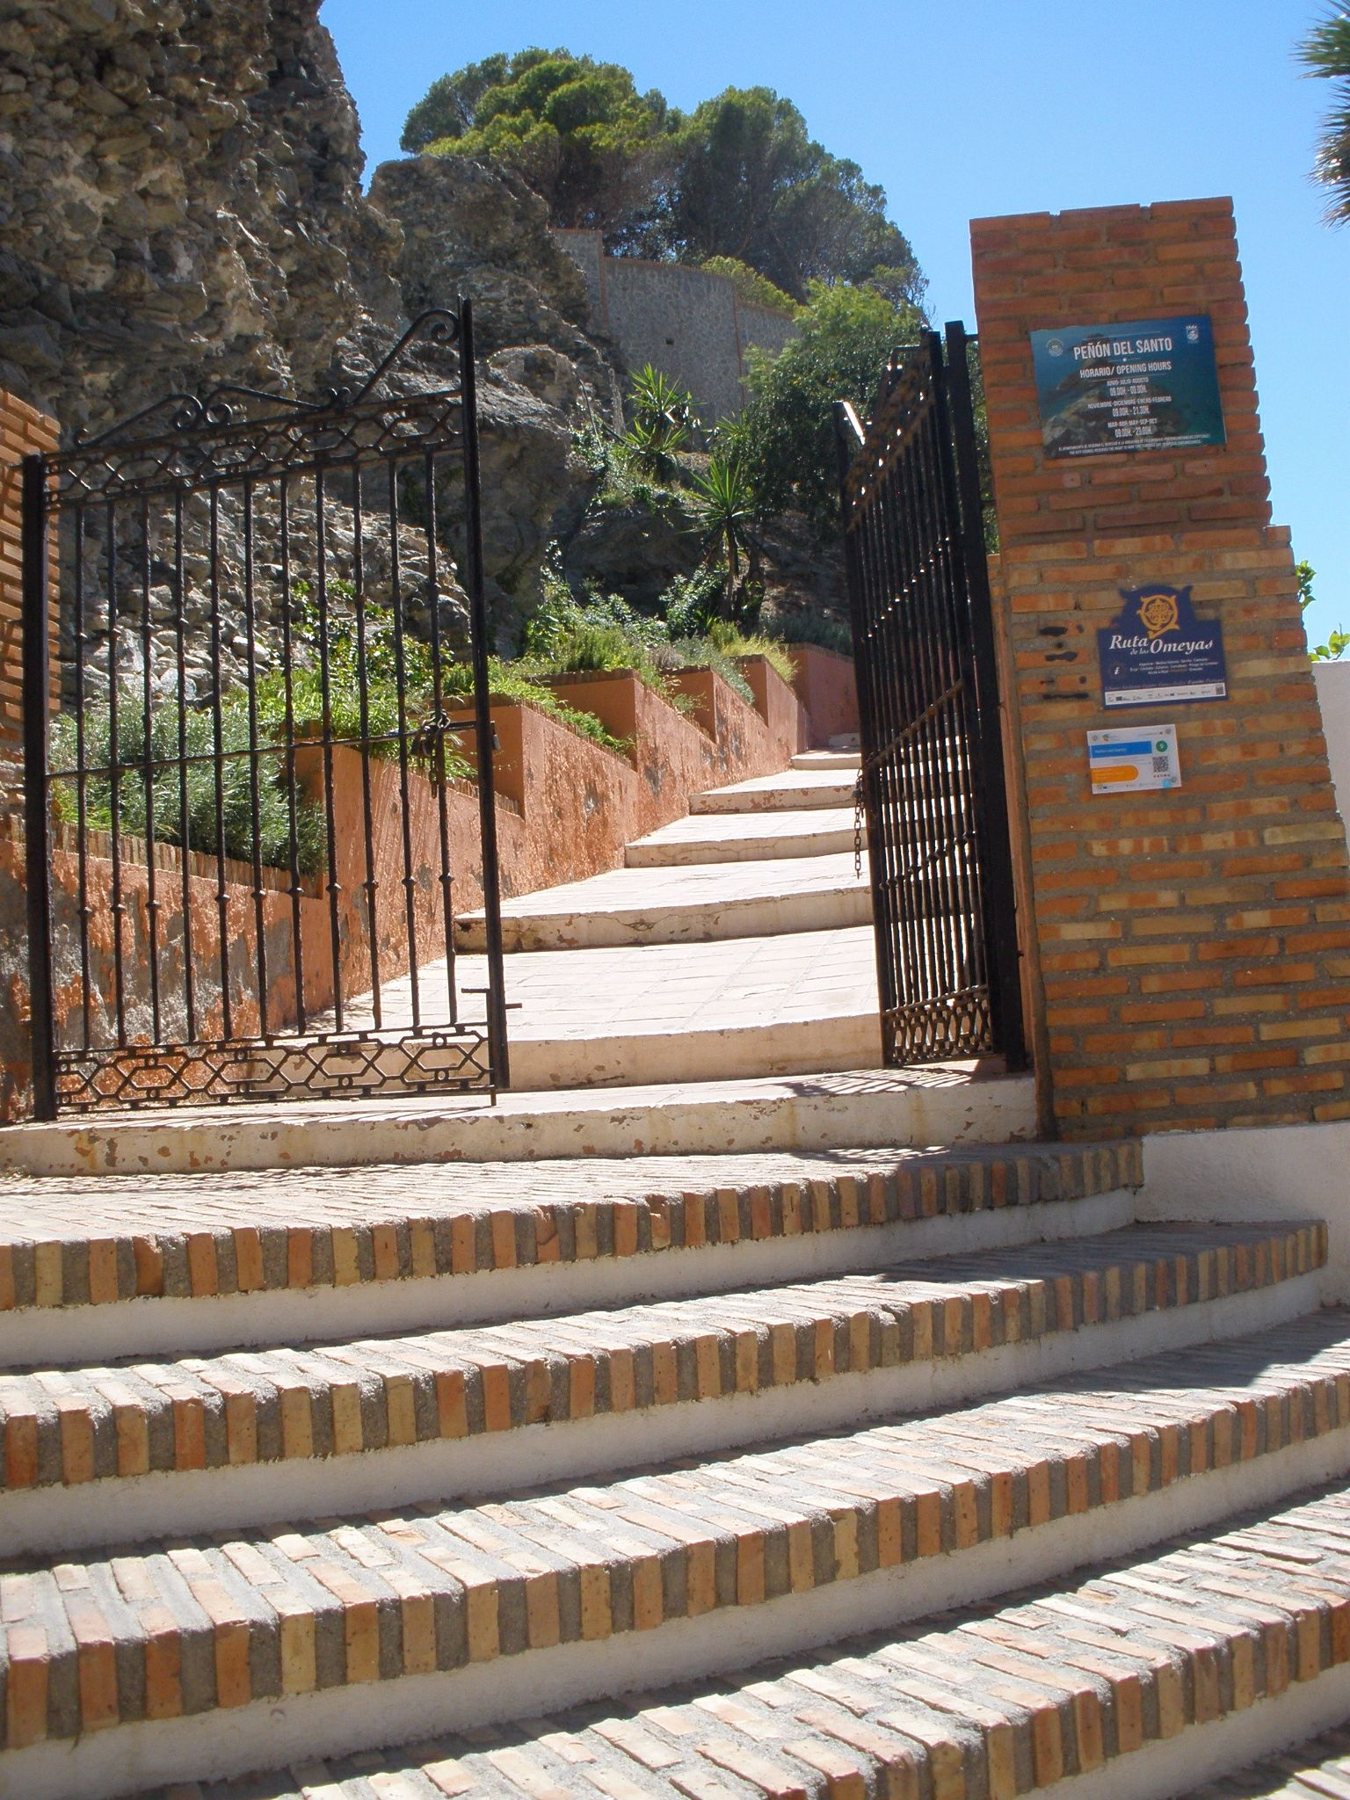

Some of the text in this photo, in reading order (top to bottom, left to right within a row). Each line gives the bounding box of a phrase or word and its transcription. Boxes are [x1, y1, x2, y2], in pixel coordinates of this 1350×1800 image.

[1074, 342, 1111, 360] PEÑÓN
[1113, 341, 1134, 356] DEL
[1136, 337, 1173, 354] SANTO
[1080, 361, 1172, 379] HORARIO/ OPENING HOURS
[1109, 634, 1149, 650] Ruta
[1150, 638, 1213, 655] Omeyas
